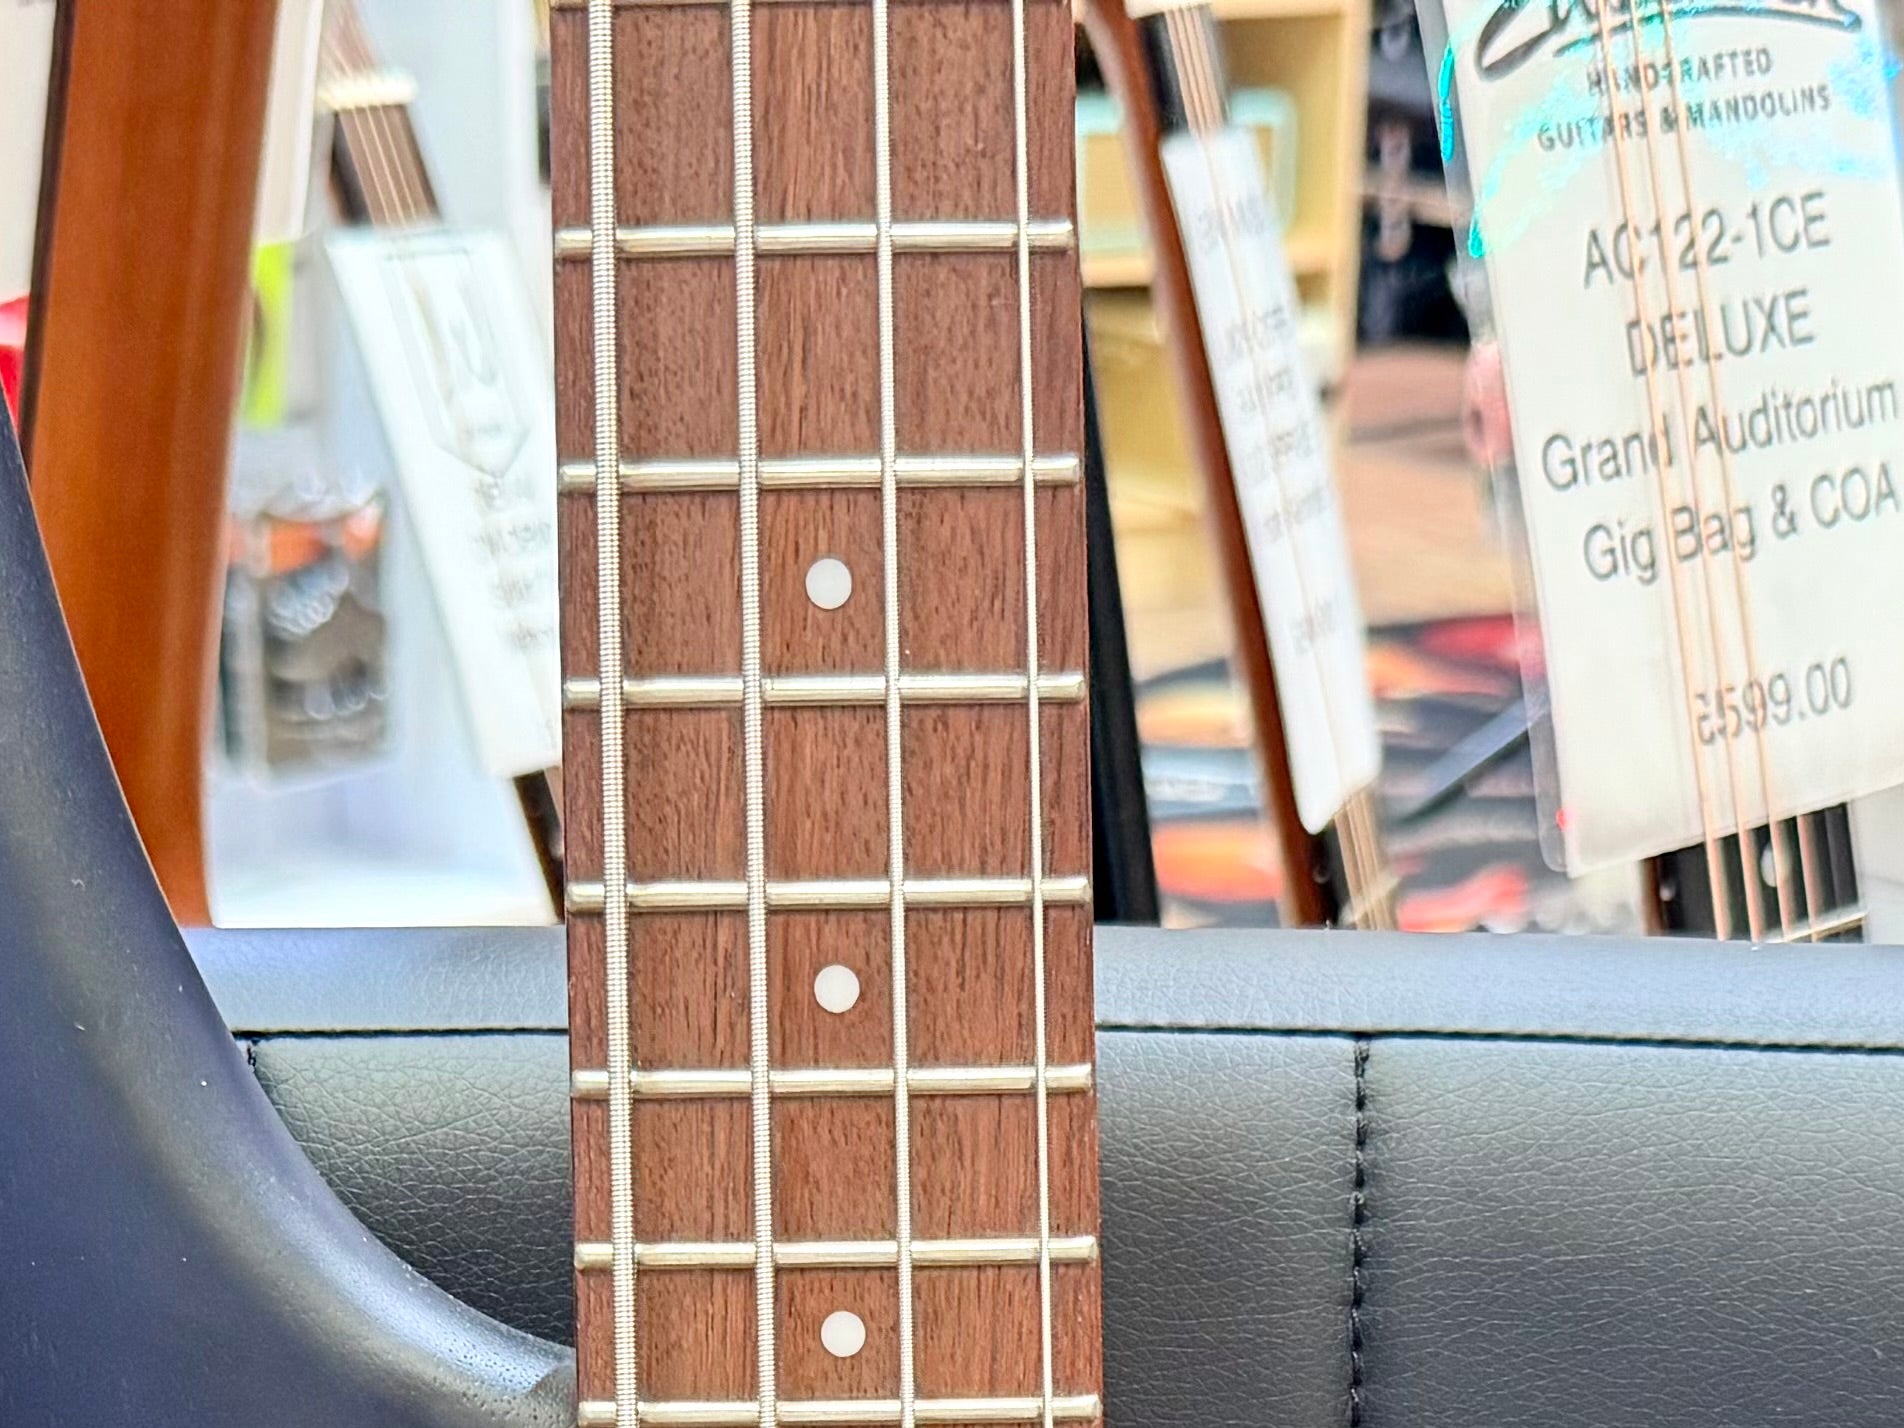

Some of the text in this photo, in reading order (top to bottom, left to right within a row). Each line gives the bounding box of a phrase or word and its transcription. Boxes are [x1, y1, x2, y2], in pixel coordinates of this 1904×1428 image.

[1659, 110, 1679, 133] &
[1685, 84, 1832, 131] MANDOLINS
[1583, 190, 1832, 290] AC122-1CE
[1625, 288, 1816, 378] DELUXE
[1542, 376, 1899, 492] Grand Auditorium
[1583, 461, 1900, 585] Gig Bag & COA
